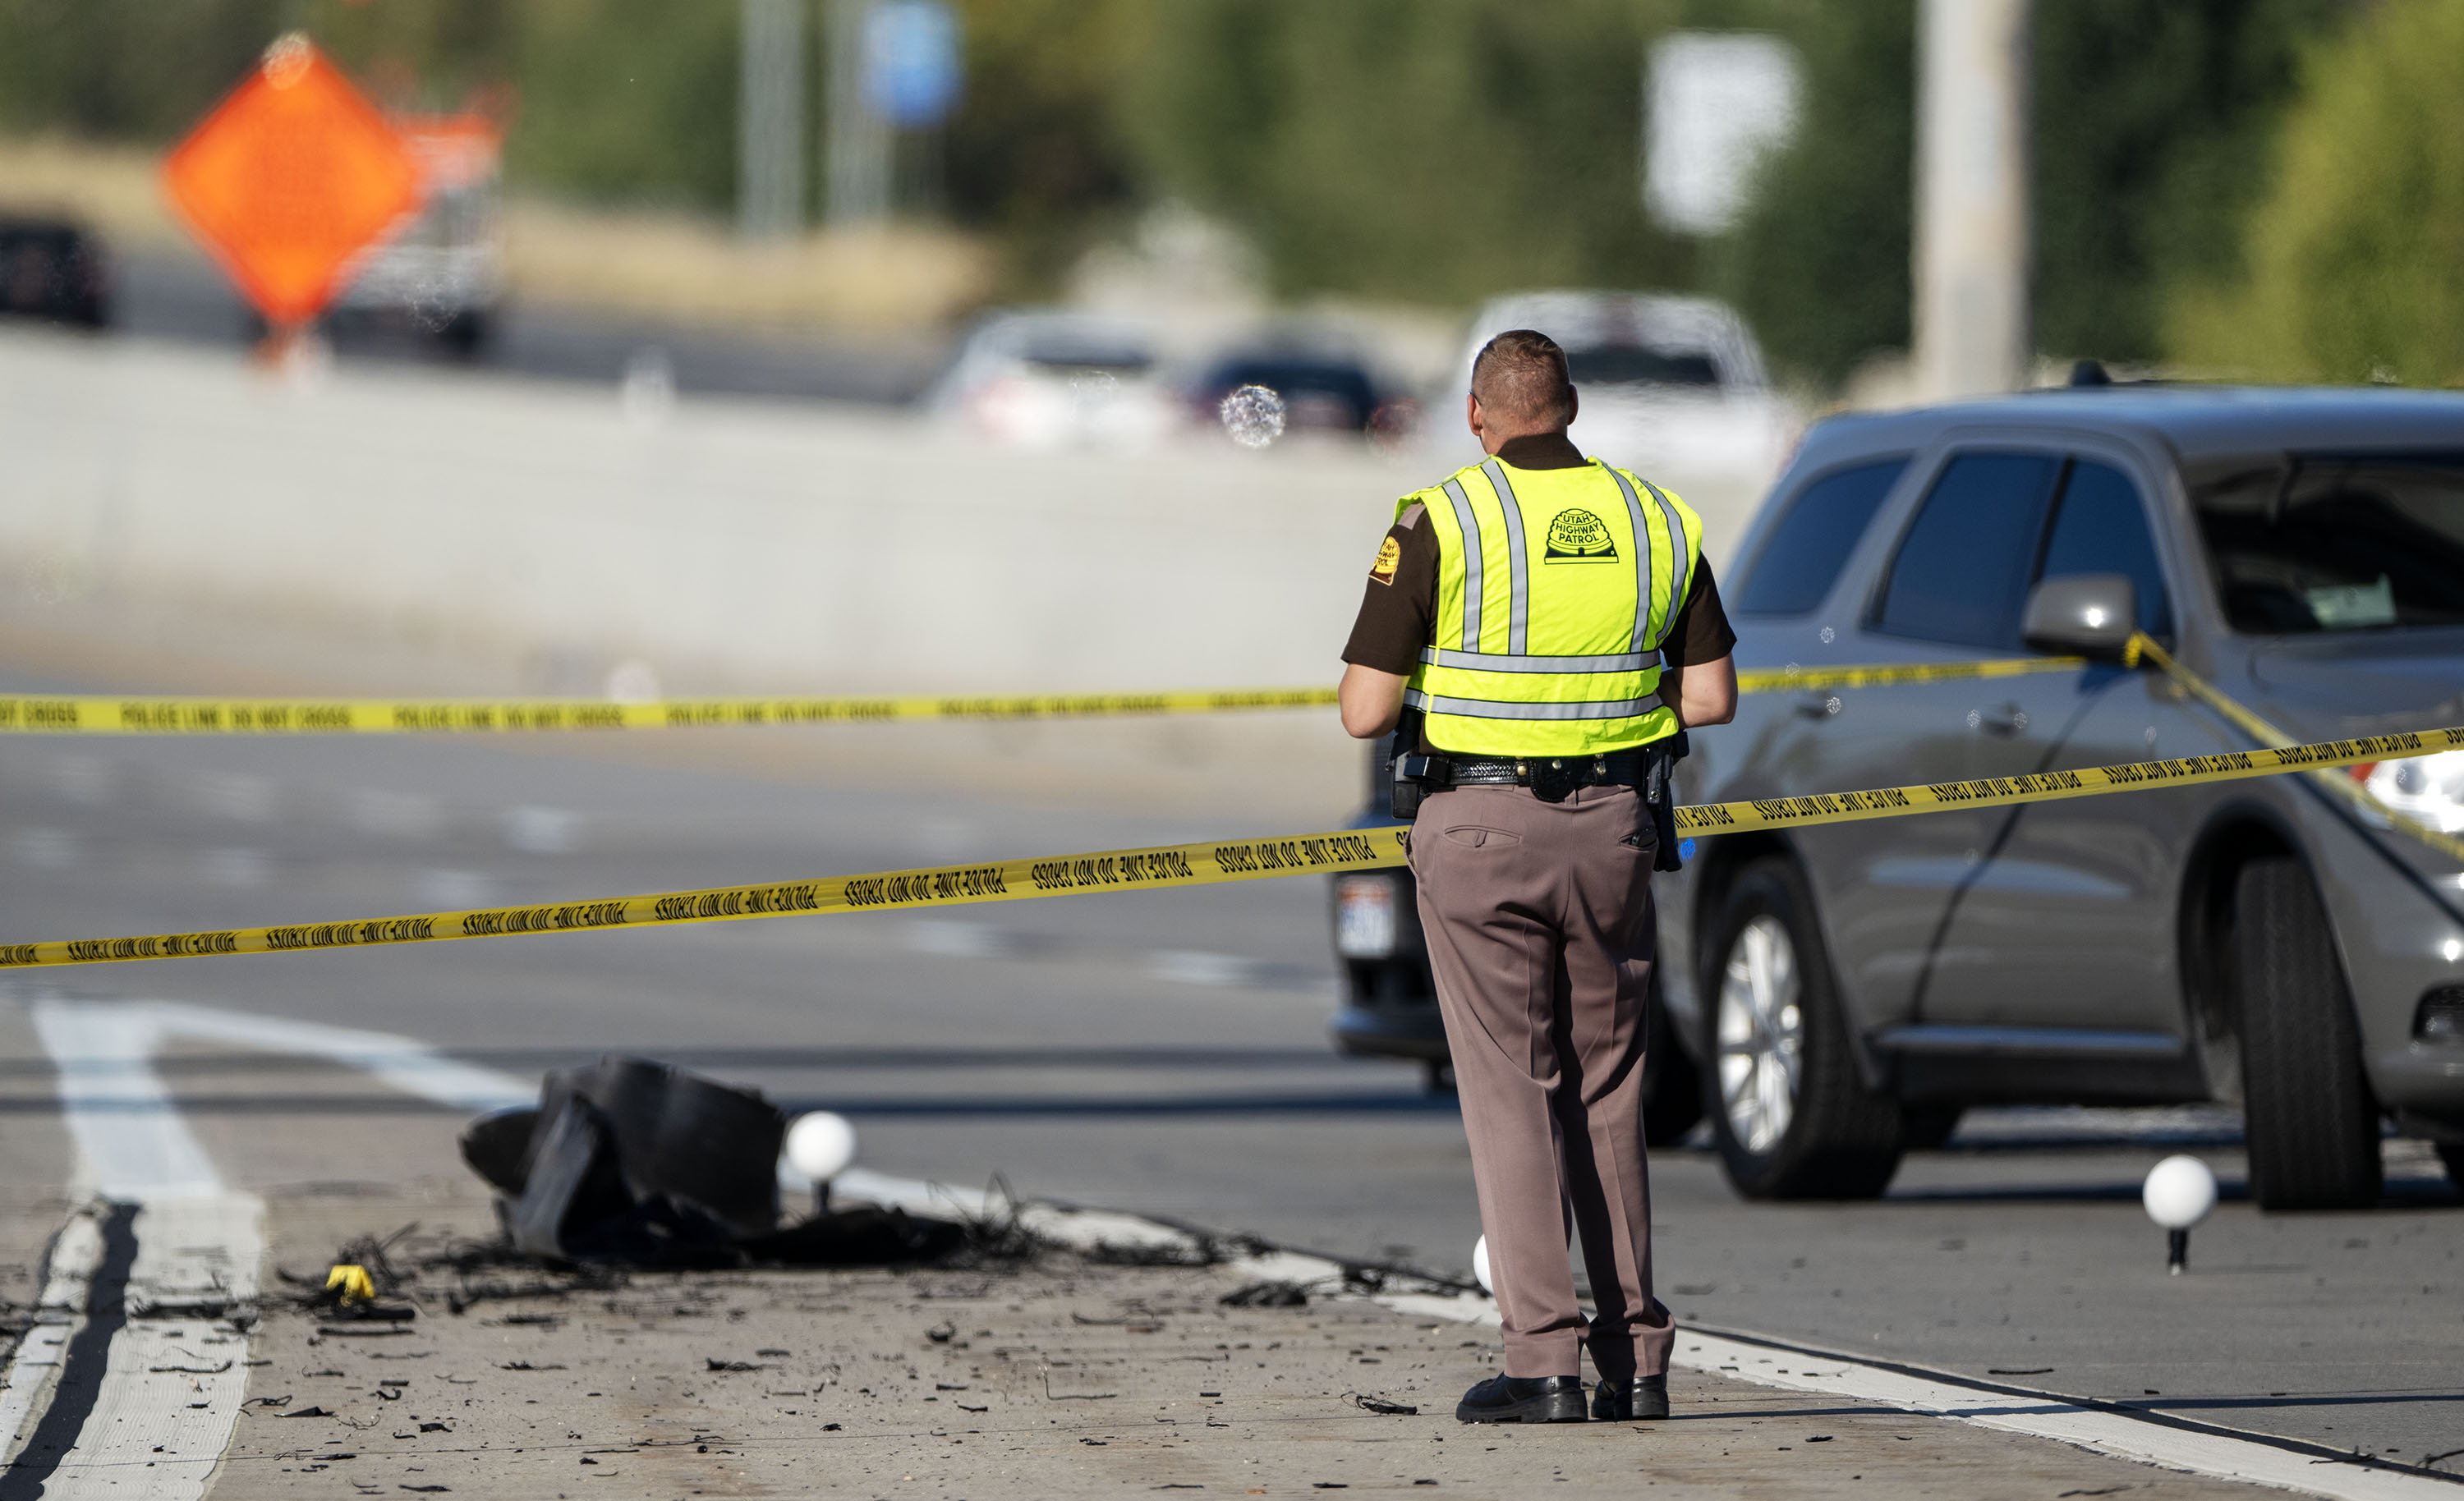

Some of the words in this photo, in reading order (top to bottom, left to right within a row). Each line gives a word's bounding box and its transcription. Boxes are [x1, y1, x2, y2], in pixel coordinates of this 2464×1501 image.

[1556, 522, 1600, 535] HIGHWAY
[1563, 514, 1590, 524] UTAH
[1559, 532, 1599, 544] PATROL
[2312, 742, 2337, 761] NOT
[2334, 740, 2355, 758] DO
[2356, 737, 2384, 755] LINE
[2382, 732, 2421, 751] POLICE
[2211, 752, 2253, 772] POLICE
[2273, 744, 2313, 764] CROSS
[2101, 764, 2143, 784] CROSS
[2141, 762, 2167, 780] NOT
[2163, 760, 2185, 778] DO
[2186, 756, 2213, 775] LINE
[1969, 780, 1996, 798] NOT
[1991, 778, 2013, 796] DO
[2014, 774, 2043, 794] LINE
[2040, 770, 2082, 791] POLICE
[1840, 792, 1869, 812] LINE
[1866, 787, 1910, 809] POLICE
[1928, 783, 1971, 802] CROSS
[1686, 803, 1735, 827] POLICE
[1751, 799, 1797, 820] CROSS
[1792, 796, 1822, 816] NOT
[1816, 795, 1840, 815] DO
[1257, 842, 1285, 870] NOT
[1281, 841, 1303, 868] DO
[1301, 838, 1335, 865] LINE
[1329, 834, 1377, 862] POLICE
[1119, 855, 1151, 882] LINE
[1147, 851, 1193, 880] POLICE
[1216, 844, 1258, 874] CROSS
[1032, 861, 1073, 890] CROSS
[1073, 859, 1100, 886] NOT
[1097, 857, 1119, 884] DO
[844, 878, 885, 907] CROSS
[888, 876, 913, 903] NOT
[912, 874, 932, 901] DO
[934, 871, 964, 898] LINE
[963, 867, 1007, 897] POLICE
[655, 895, 697, 920] CROSS
[698, 893, 724, 917] NOT
[723, 892, 743, 915] DO
[746, 888, 775, 914] LINE
[775, 884, 819, 911] POLICE
